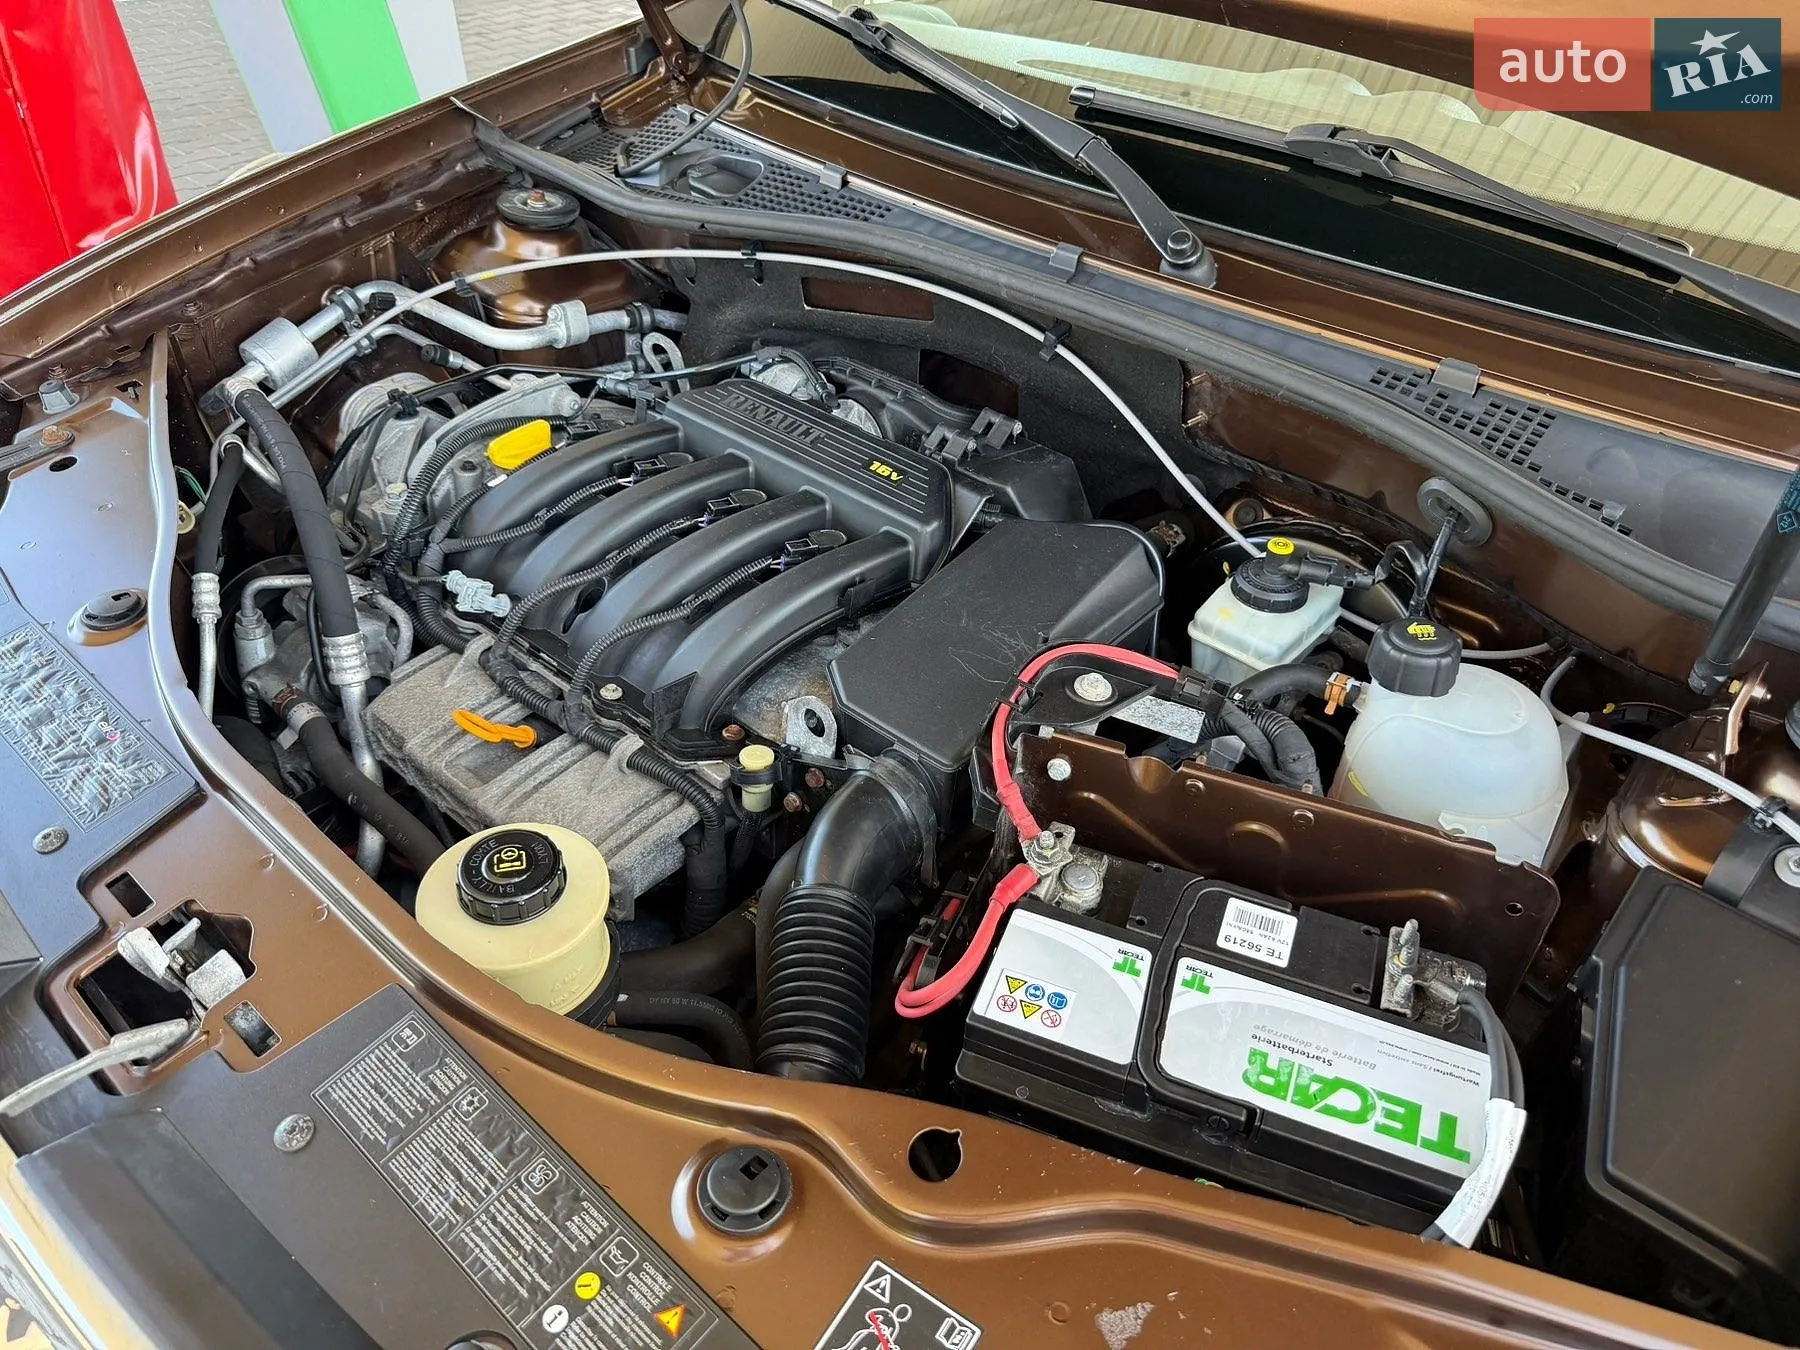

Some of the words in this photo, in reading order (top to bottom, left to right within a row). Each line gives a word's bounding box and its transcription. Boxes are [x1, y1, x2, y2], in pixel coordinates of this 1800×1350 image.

[720, 392, 825, 447] RENAULT
[1117, 948, 1144, 961] TECAR
[1223, 934, 1262, 952] 56219
[1265, 947, 1284, 960] TE
[1185, 964, 1213, 978] TECAR
[1250, 1033, 1333, 1067] Starterbatterie
[1253, 1023, 1311, 1050] démarrage
[1313, 1042, 1328, 1055] de
[1330, 1047, 1376, 1070] Batterie
[1242, 1047, 1471, 1164] TECAR
[571, 1214, 596, 1239] ACHTUNG
[580, 1210, 602, 1234] CAUTION
[581, 1200, 609, 1228] ATTENTION
[626, 1271, 660, 1305] KONTROLLE
[639, 1270, 667, 1299] CONTROL
[642, 1261, 672, 1292] CONTROLE
[626, 1284, 654, 1313] CONTROL
